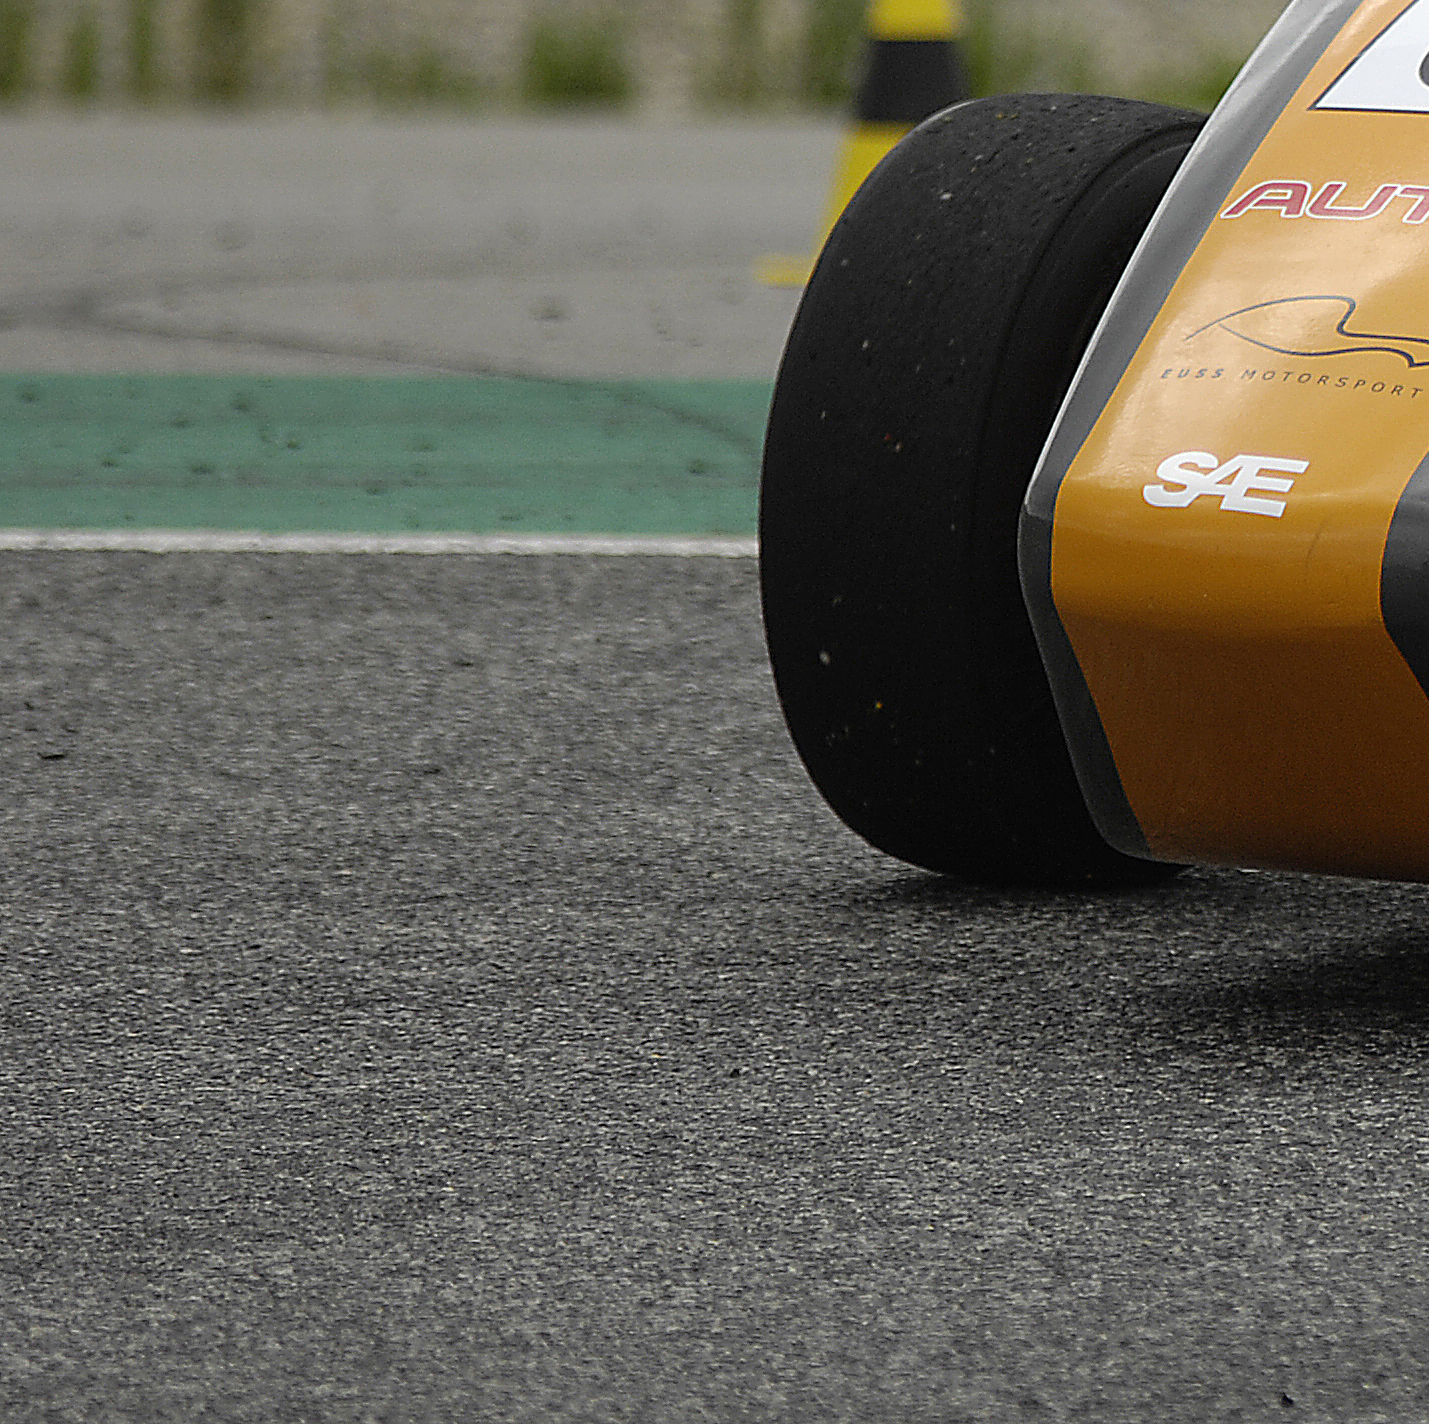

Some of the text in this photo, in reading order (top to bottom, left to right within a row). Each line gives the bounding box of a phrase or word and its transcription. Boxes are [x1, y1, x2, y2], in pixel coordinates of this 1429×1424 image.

[1160, 368, 1424, 398] EUSS MOTORSPORT
[1143, 451, 1310, 518] SAE
